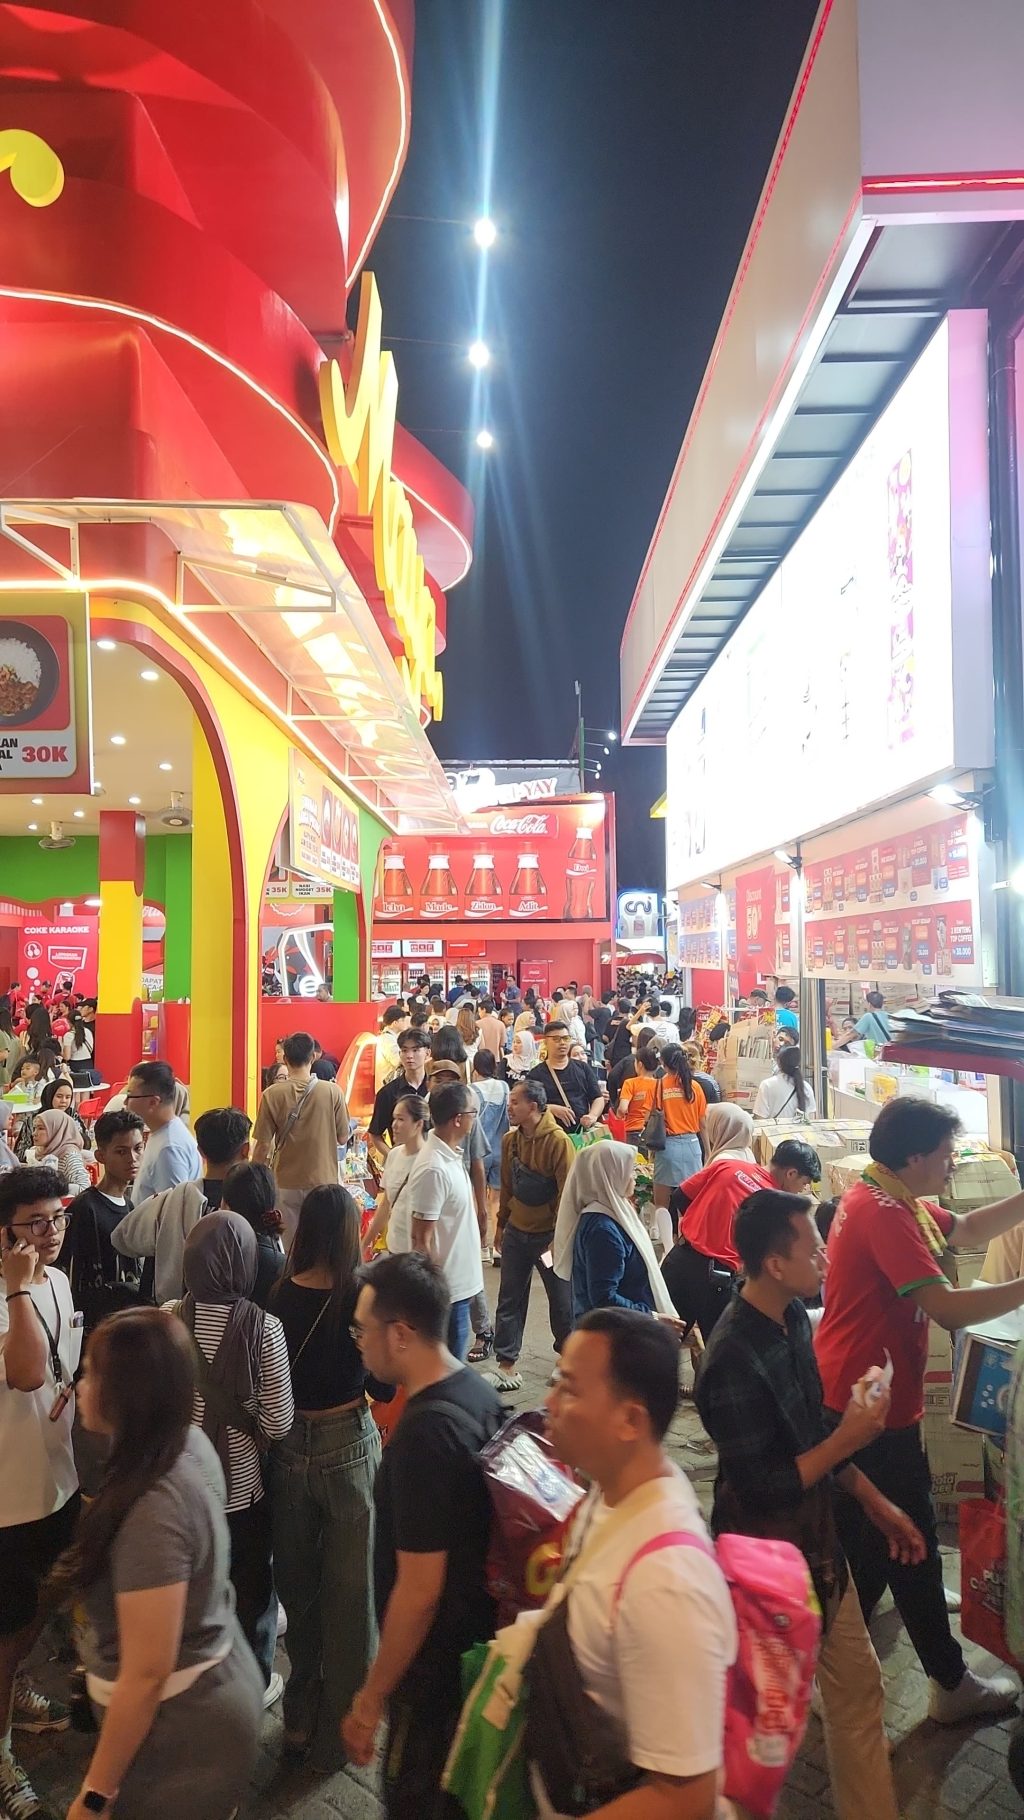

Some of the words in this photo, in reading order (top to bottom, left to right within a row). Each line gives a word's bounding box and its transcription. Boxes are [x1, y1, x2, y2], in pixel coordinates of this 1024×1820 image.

[22, 746, 69, 763] 30K
[519, 901, 539, 912] Adit
[24, 926, 47, 934] COKE
[49, 926, 89, 934] KARAOKE
